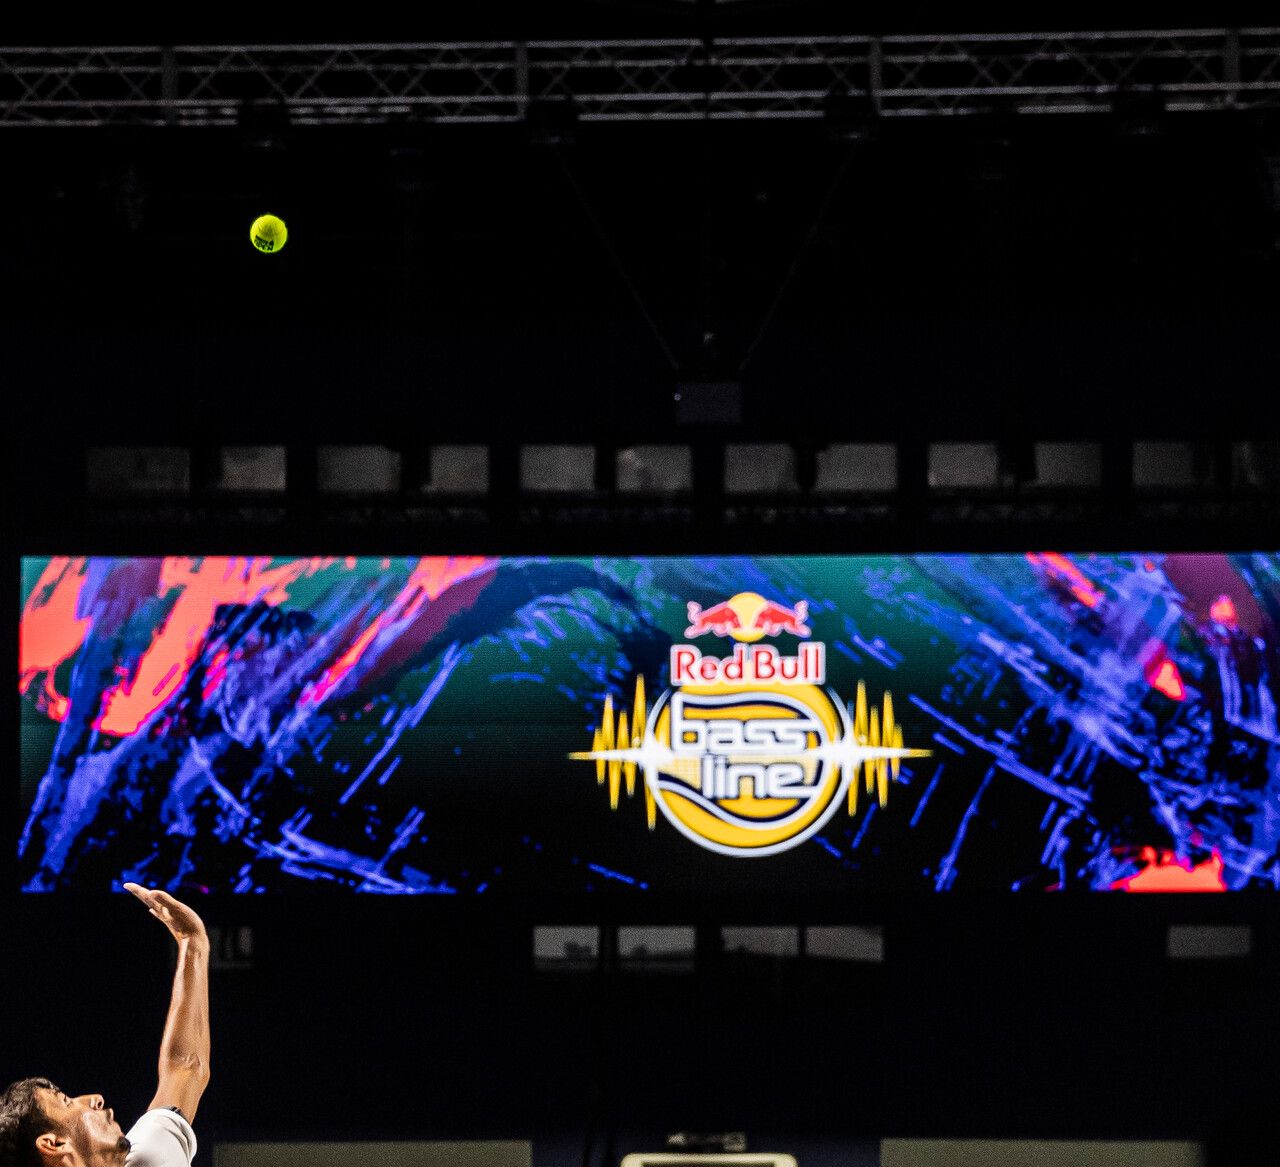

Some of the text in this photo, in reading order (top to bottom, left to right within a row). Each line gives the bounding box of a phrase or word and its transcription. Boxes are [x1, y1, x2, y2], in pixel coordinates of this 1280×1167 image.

[675, 647, 821, 681] Red Bull
[671, 692, 815, 753] bass
[702, 753, 813, 799] line
